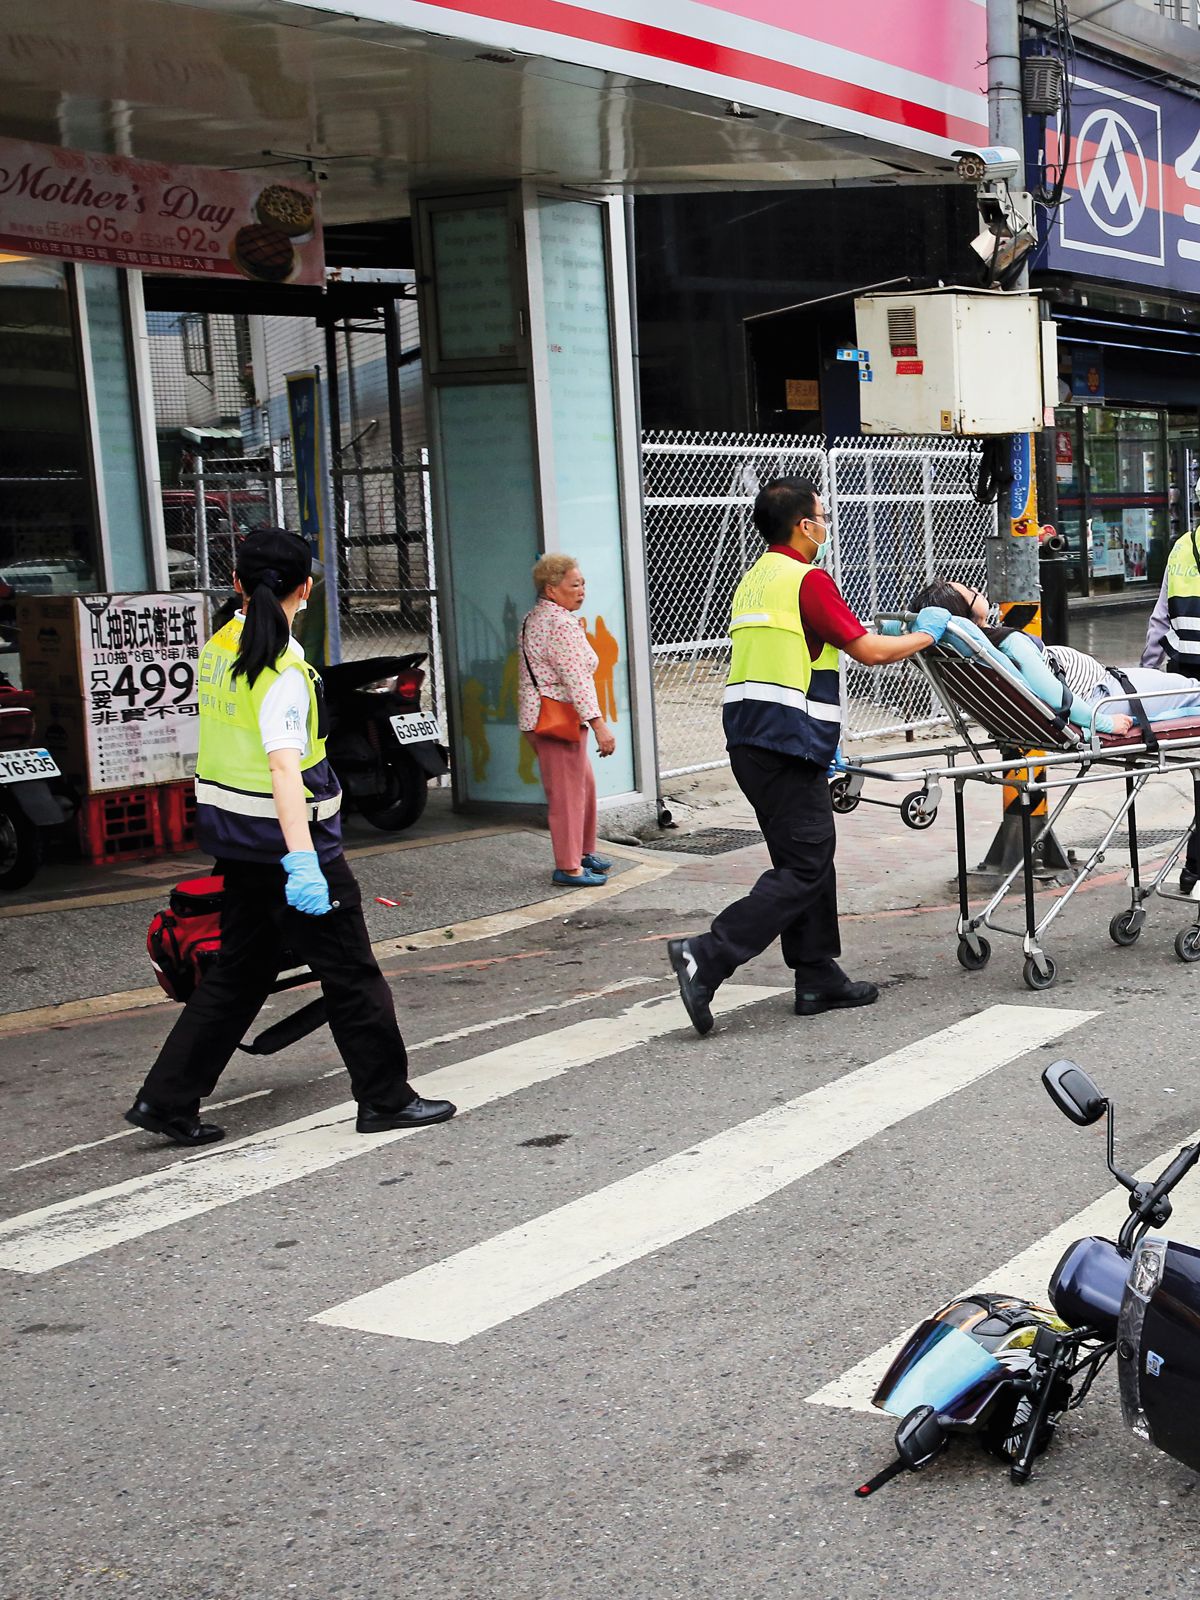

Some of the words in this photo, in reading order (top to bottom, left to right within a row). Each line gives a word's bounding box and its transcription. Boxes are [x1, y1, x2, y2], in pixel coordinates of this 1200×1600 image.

[0, 162, 145, 214] Mother's
[159, 186, 236, 231] Day
[111, 661, 194, 708] 499
[91, 703, 199, 725] 非買不可
